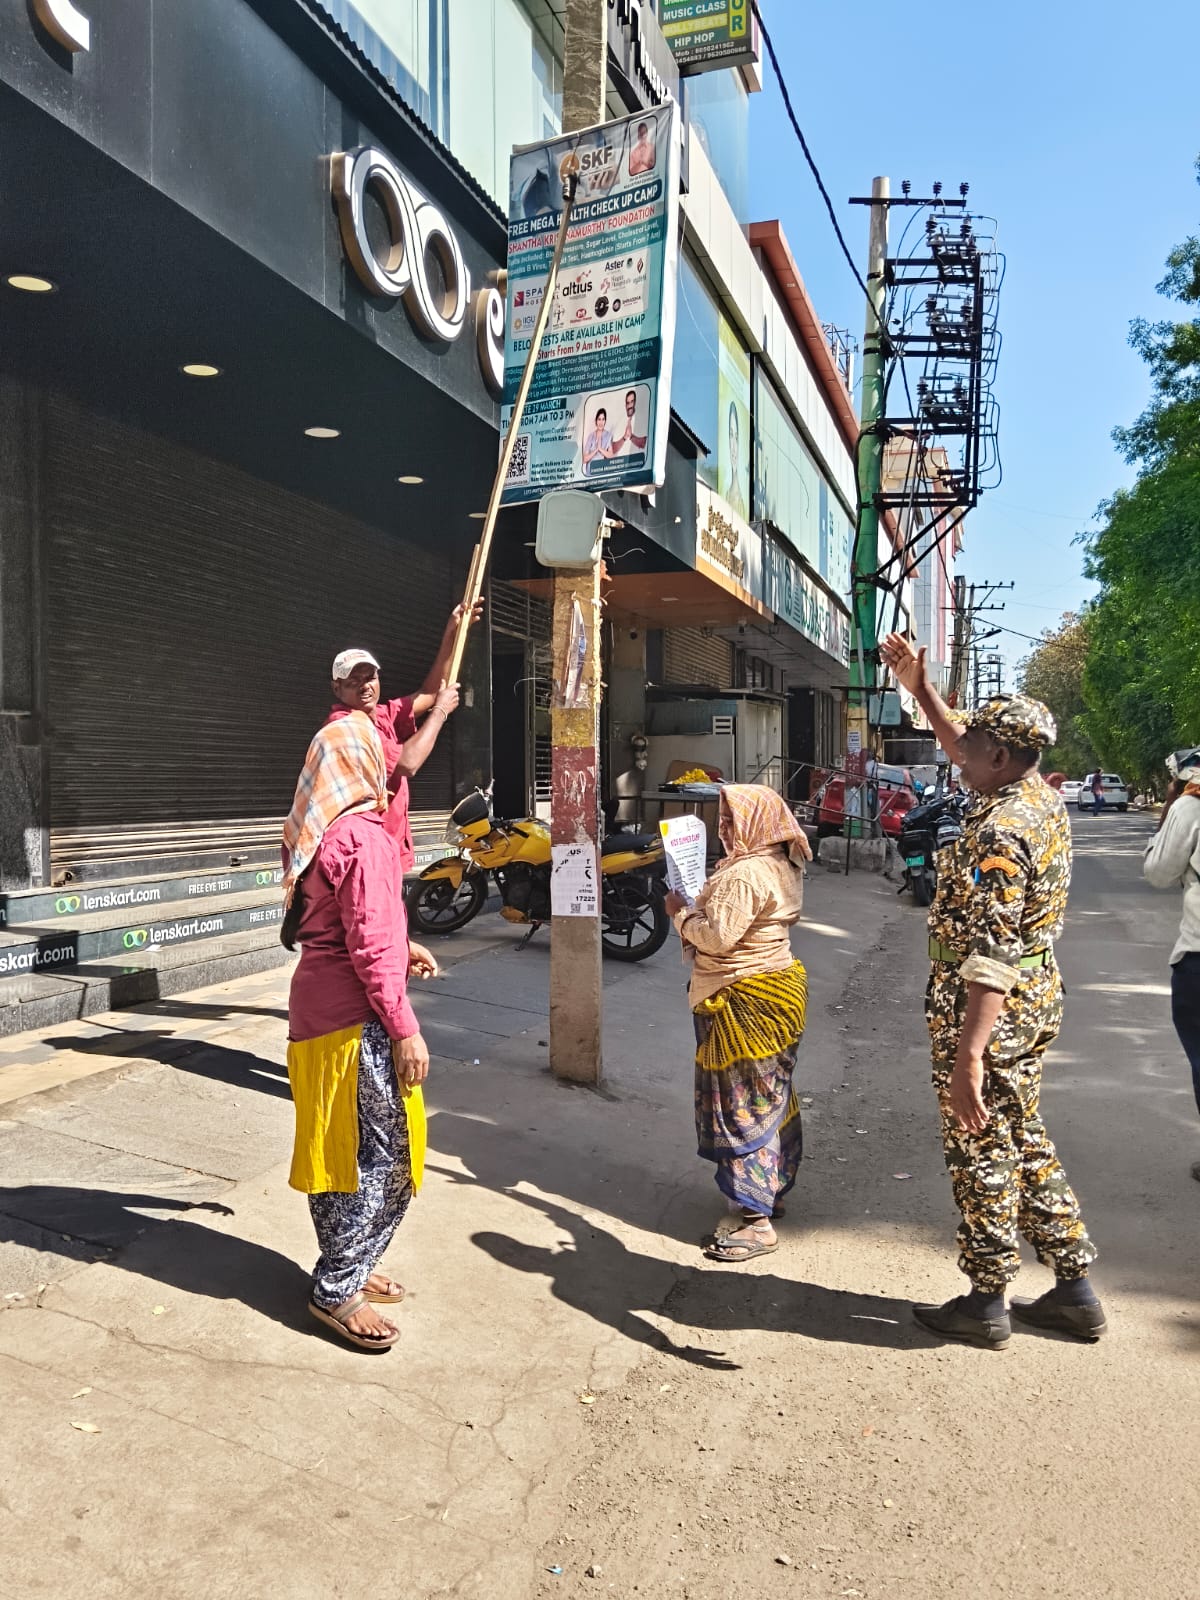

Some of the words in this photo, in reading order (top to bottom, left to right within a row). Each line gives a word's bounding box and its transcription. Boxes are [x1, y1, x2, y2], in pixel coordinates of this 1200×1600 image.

[663, 6, 693, 21] MUSIC
[695, 1, 726, 14] CLASS
[674, 36, 691, 48] HIP
[694, 31, 715, 44] HOP
[581, 145, 613, 171] SKF
[508, 221, 529, 238] FREE
[530, 216, 555, 233] MEGA
[557, 205, 590, 227] HALTH
[590, 199, 620, 216] CHECK
[622, 194, 633, 208] UP
[634, 185, 659, 202] CAMP
[508, 235, 543, 254] SHANTHA
[544, 219, 607, 246] KRINAMURTHY
[608, 205, 656, 228] FOUNDATION
[586, 239, 602, 249] Sugar
[604, 258, 625, 272] Aster
[525, 283, 561, 298] SPAH
[562, 280, 593, 297] altius
[540, 333, 559, 347] TESTS
[560, 329, 575, 343] ARE
[576, 321, 615, 341] AVAILABLE
[615, 319, 623, 331] IN
[624, 313, 646, 329] CAMP
[537, 347, 556, 361] Starts
[557, 344, 574, 357] From
[575, 341, 581, 351] 9
[581, 339, 593, 351] Am
[594, 338, 601, 349] to
[603, 336, 608, 346] 3
[609, 334, 621, 346] PM
[540, 399, 561, 411] MARCH
[520, 416, 534, 427] ROM
[549, 411, 558, 421] TO
[559, 411, 564, 420] 3
[565, 409, 575, 419] PM
[83, 887, 161, 910] lenskart.com
[188, 882, 204, 895] FREE
[205, 881, 217, 893] EYE
[217, 880, 233, 892] TEST
[149, 918, 224, 943] lenskart.com
[250, 910, 264, 923] FREE
[265, 908, 277, 921] EYE
[0, 943, 75, 972] skart.com
